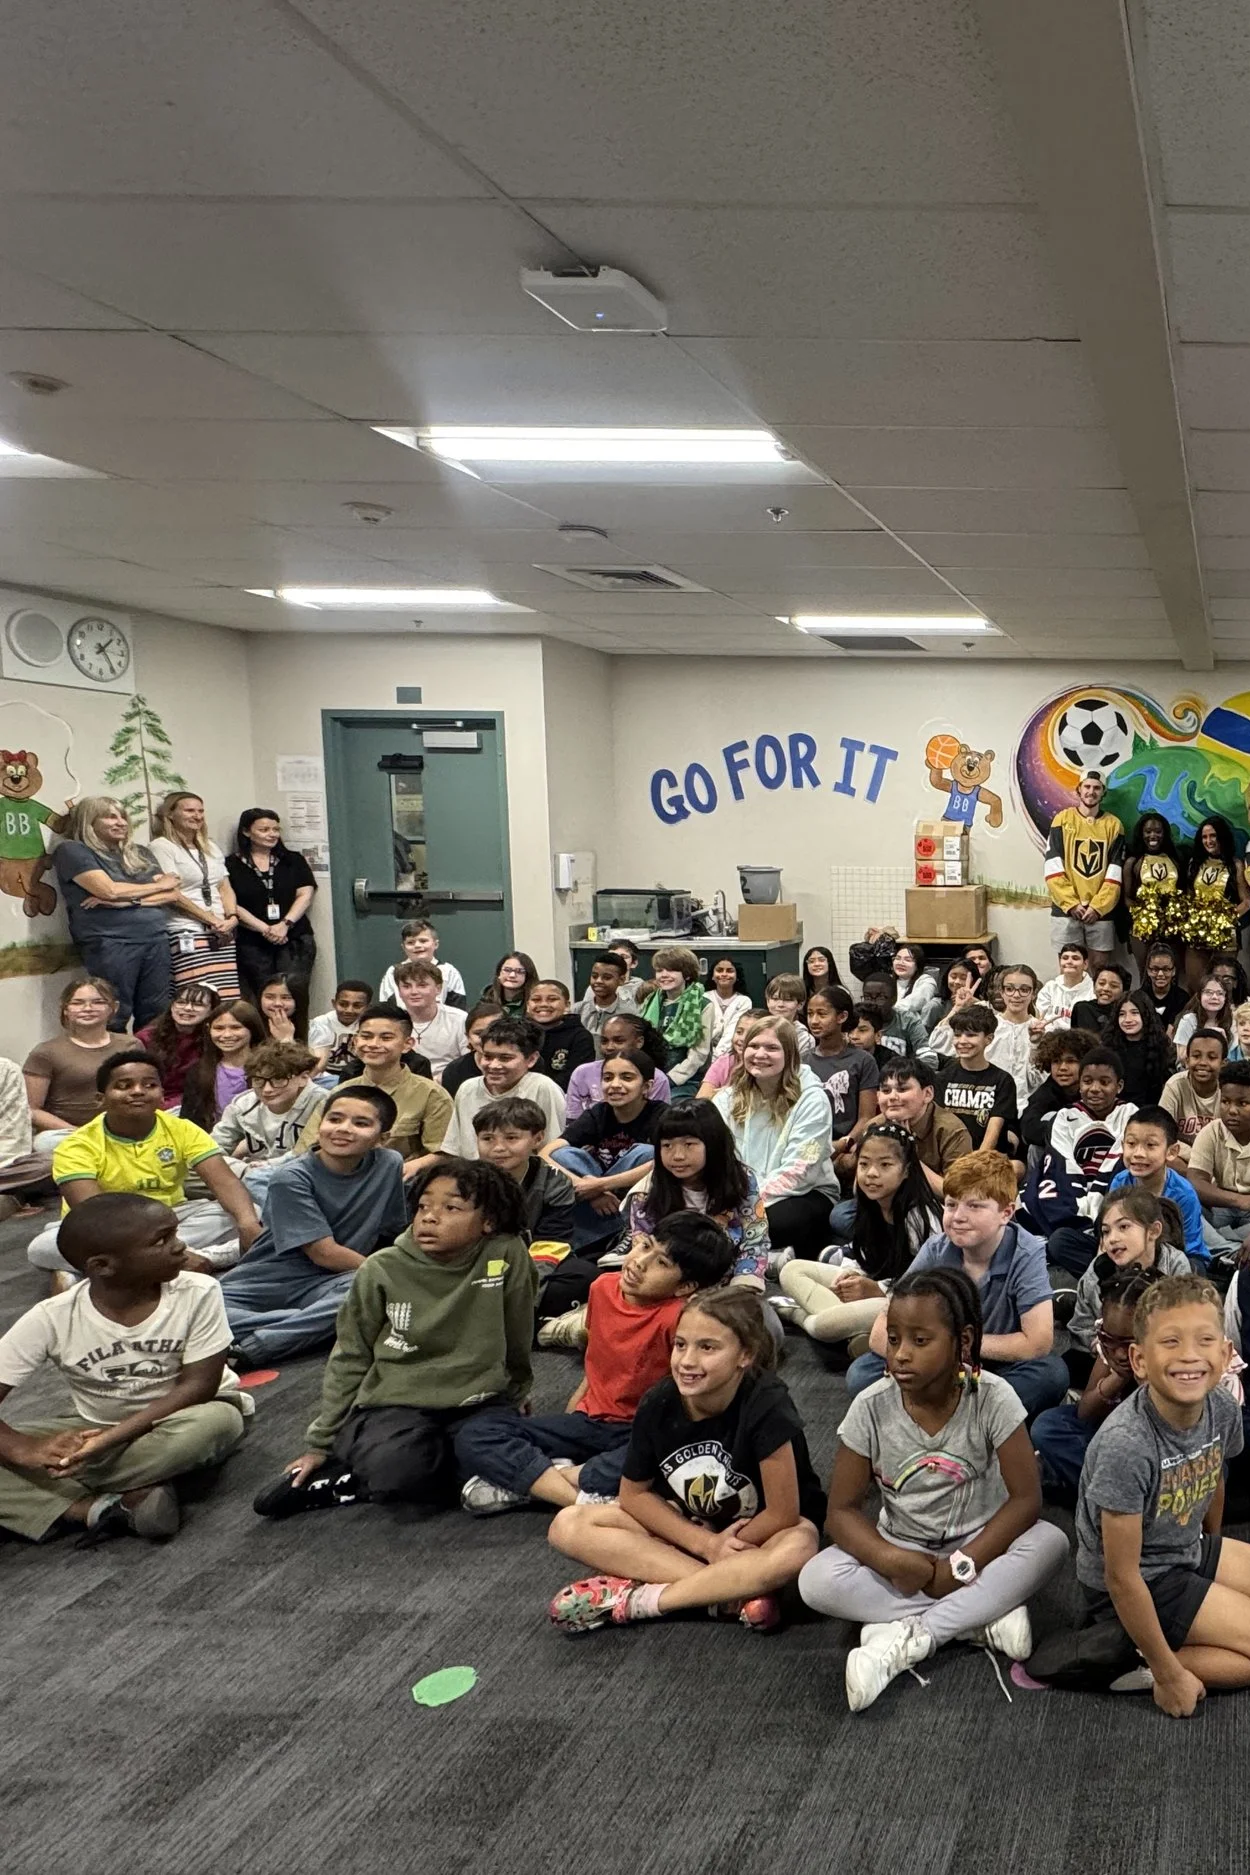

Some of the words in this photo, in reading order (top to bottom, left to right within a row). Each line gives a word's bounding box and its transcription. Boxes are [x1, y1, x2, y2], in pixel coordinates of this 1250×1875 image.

[651, 763, 717, 825] GO
[722, 732, 821, 802] FOR
[833, 737, 899, 803] IT
[5, 812, 31, 835] BB
[944, 1088, 995, 1109] CHAMPS
[76, 1341, 126, 1373] FILA
[675, 1443, 719, 1464] GOLDEN
